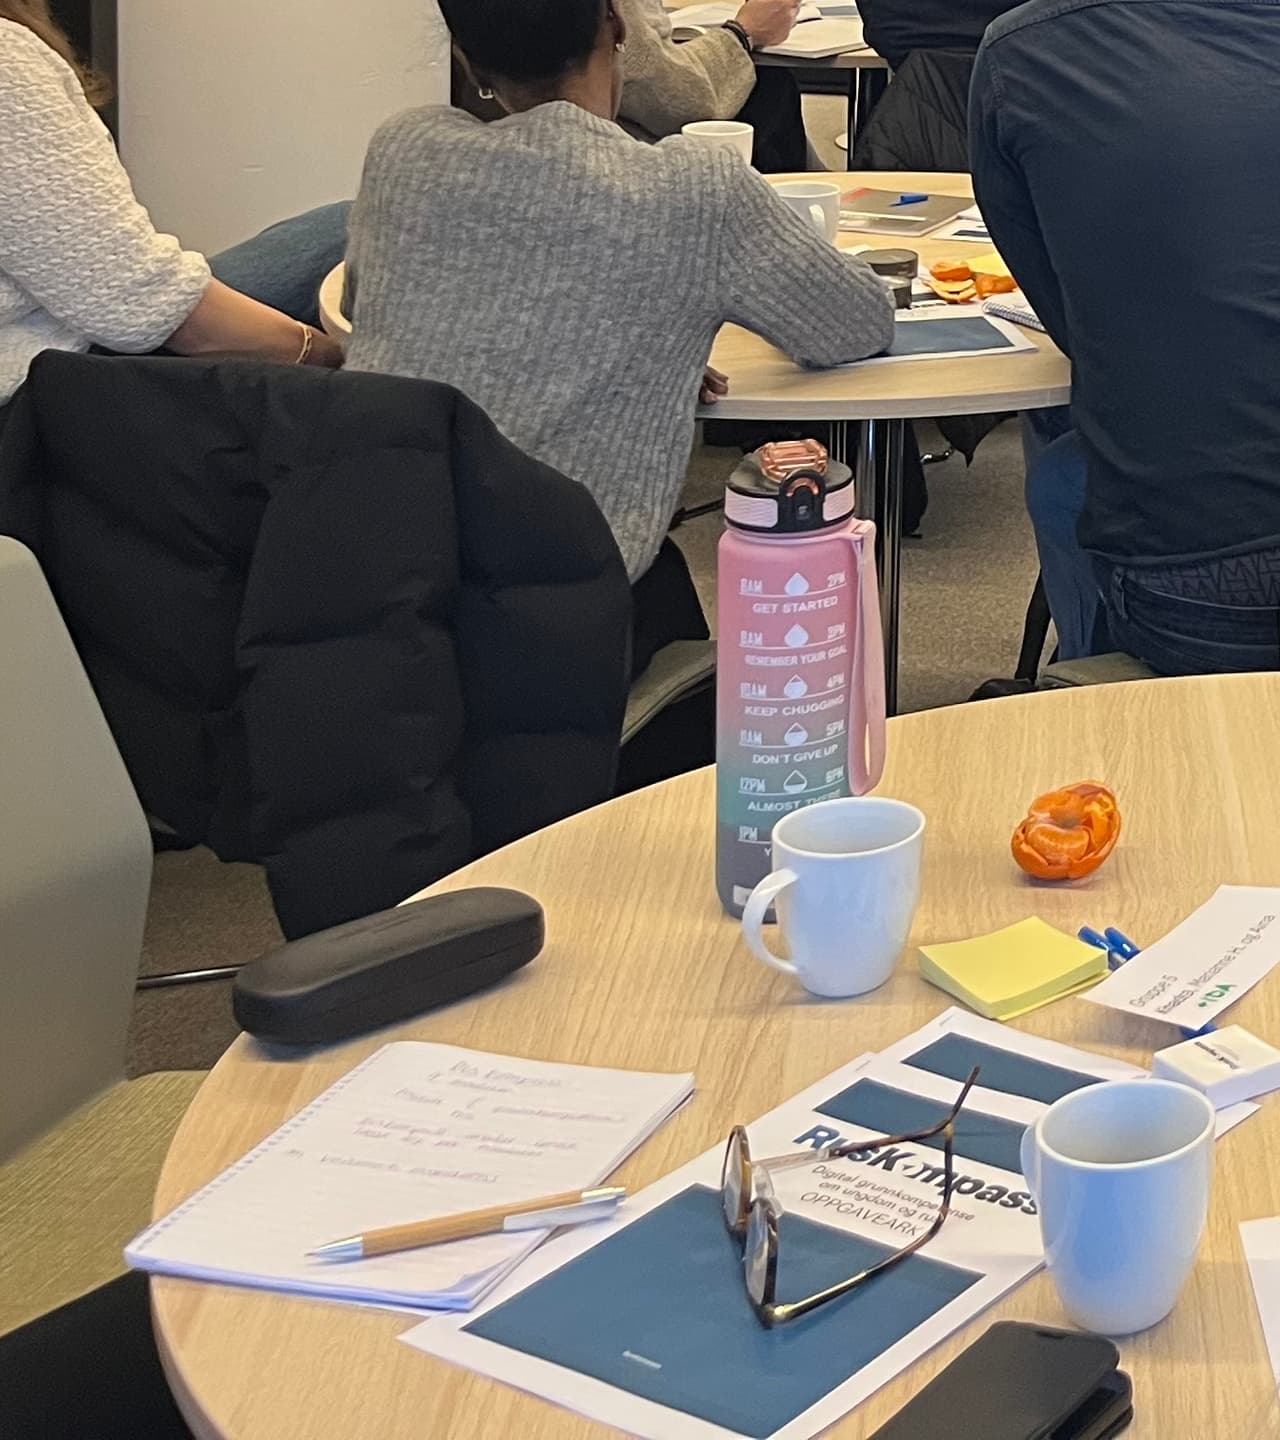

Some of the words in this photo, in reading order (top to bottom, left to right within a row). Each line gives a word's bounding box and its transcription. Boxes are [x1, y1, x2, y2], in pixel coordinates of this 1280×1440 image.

[752, 602, 778, 614] GET
[782, 596, 839, 614] STARTED
[744, 654, 798, 666] REMEMBER
[798, 650, 827, 665] YOUR
[744, 705, 778, 717] KEEP
[782, 694, 844, 716] CHUGGING
[752, 753, 791, 764] DON'T
[793, 748, 822, 762] GIVE
[823, 744, 839, 755] UP
[747, 800, 801, 812] ALMOST
[812, 1165, 861, 1183] Digital
[818, 1182, 841, 1192] om
[842, 1186, 897, 1210] ungdom
[897, 1206, 918, 1218] og
[800, 1191, 923, 1237] OPPGAVEARK
